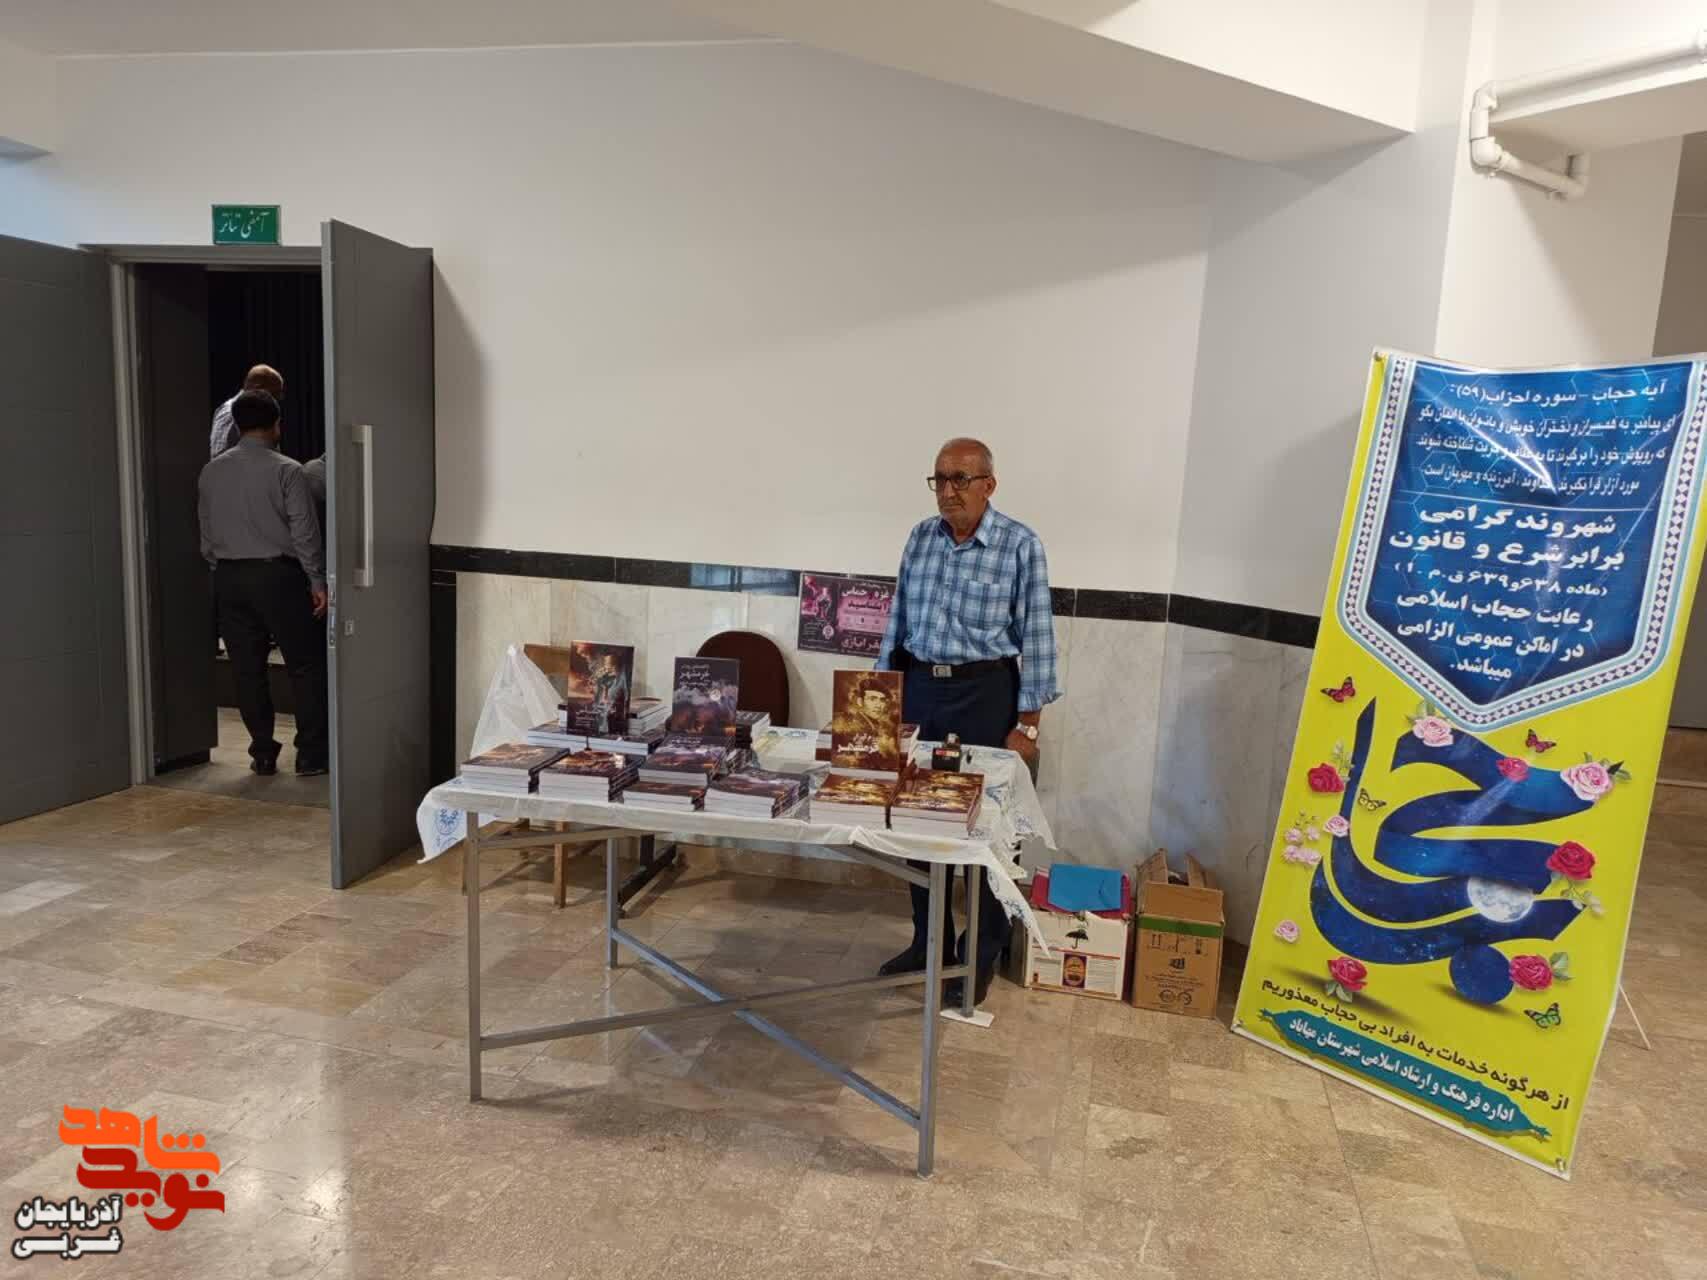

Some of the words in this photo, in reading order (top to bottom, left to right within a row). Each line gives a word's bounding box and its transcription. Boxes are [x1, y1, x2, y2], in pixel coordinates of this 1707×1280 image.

[1532, 393, 1577, 408] سوره
[1592, 386, 1638, 406] حجاب
[1640, 378, 1668, 401] آیه
[1630, 415, 1661, 436] پیامبر
[1662, 414, 1677, 432] ای
[1590, 447, 1599, 465] را
[1600, 446, 1619, 465] خود
[1515, 512, 1616, 538] شهروند
[1389, 529, 1466, 552] قانون
[1471, 543, 1490, 560] و
[1497, 542, 1563, 566] شرع
[1396, 588, 1468, 611] اسلامی
[1471, 599, 1532, 623] حجاب
[1536, 607, 1594, 633] رعایت
[1397, 619, 1455, 641] الزامی
[1455, 631, 1514, 651] عمومی
[1515, 635, 1559, 656] اماکن
[1559, 642, 1585, 662] در
[1261, 978, 1319, 1008] معذوریم
[1320, 1003, 1358, 1022] حجاب
[1358, 1017, 1377, 1034] بی
[1378, 1025, 1416, 1047] افراد
[1316, 1030, 1361, 1057] شهرستان
[1417, 1039, 1434, 1057] به
[1360, 1051, 1400, 1074] اسلامی
[1436, 1047, 1489, 1075] خدمات
[1400, 1064, 1432, 1090] ارشاد
[1430, 1081, 1440, 1096] و
[1441, 1081, 1481, 1111] فرهنگ
[1482, 1100, 1515, 1123] اداره
[1551, 1093, 1570, 1111] از
